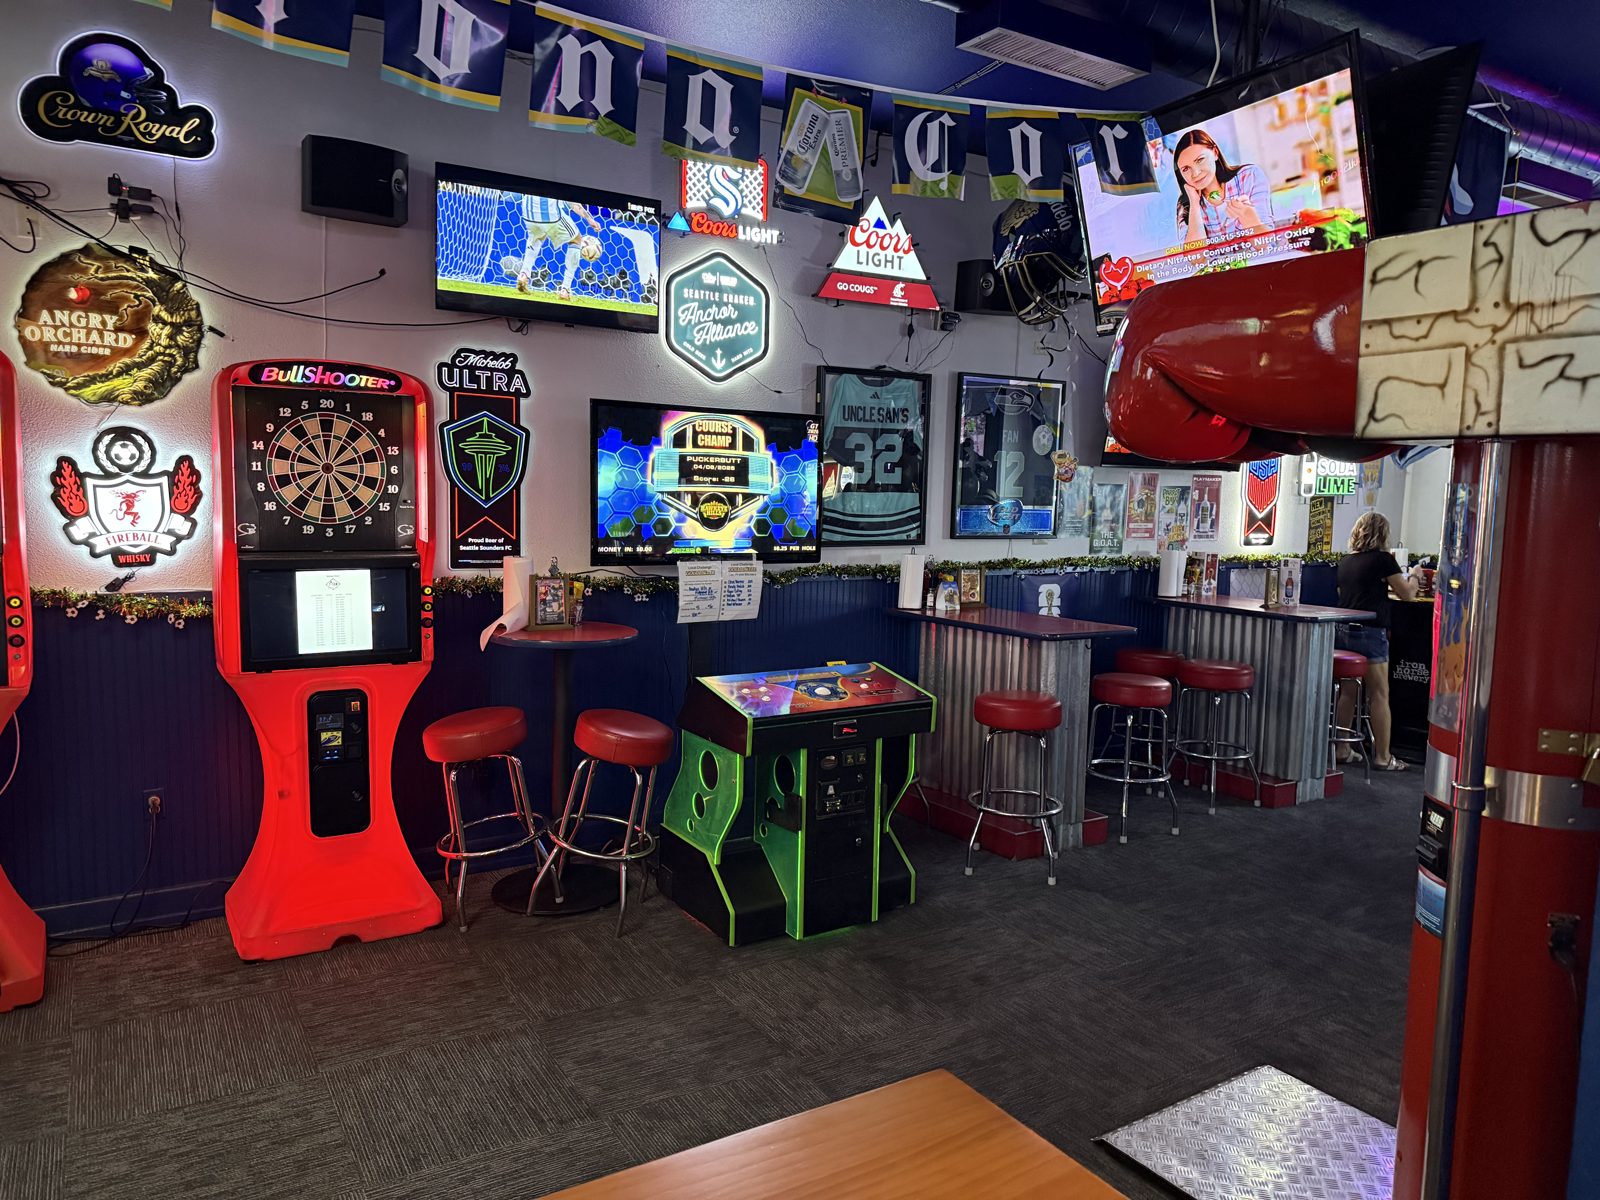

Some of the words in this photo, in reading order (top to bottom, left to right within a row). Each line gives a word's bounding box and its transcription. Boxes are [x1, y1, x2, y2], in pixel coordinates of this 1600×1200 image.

[37, 90, 115, 128] Crown
[98, 103, 200, 144] Royal
[796, 113, 820, 156] Corona
[835, 119, 849, 168] PREMIER
[1048, 201, 1074, 232] delo
[690, 212, 738, 238] Coors
[738, 225, 780, 244] LIGHT
[849, 218, 914, 255] Coors
[1136, 261, 1165, 273] Dietary
[1167, 253, 1201, 266] Nitrates
[1202, 244, 1239, 257] Convert
[1240, 241, 1252, 249] to
[1254, 233, 1282, 247] Nitric
[1284, 226, 1316, 239] Oxide
[1165, 246, 1182, 256] CALL
[856, 250, 905, 271] LIGHT
[1157, 269, 1170, 278] the
[1172, 264, 1194, 276] Body
[1195, 262, 1204, 270] to
[1207, 254, 1234, 267] Lower
[1237, 248, 1264, 261] Blood
[1266, 239, 1311, 255] Pressure
[836, 282, 849, 291] GO
[849, 284, 874, 294] COUGS
[683, 288, 720, 301] SEATTLE
[38, 309, 120, 331] ANGRY
[677, 302, 738, 326] Anchor
[24, 325, 134, 348] ORCHARD
[693, 321, 759, 345] Alliance
[50, 344, 78, 353] HARD
[80, 345, 112, 356] CIDER
[455, 352, 514, 370] Michelob
[442, 367, 527, 393] ULTRA
[301, 400, 309, 410] 5
[319, 399, 335, 409] 20
[345, 403, 351, 412] 1
[278, 408, 292, 417] 12
[361, 412, 374, 422] 18
[842, 405, 876, 423] UNCLE
[266, 423, 274, 432] 9
[377, 428, 386, 438] 4
[695, 420, 733, 434] COURSE
[697, 433, 732, 448] CHAMP
[1003, 429, 1020, 443] FAN
[252, 441, 265, 450] 14
[387, 446, 399, 455] 13
[686, 455, 742, 464] PUCKERBUTT
[844, 432, 904, 485] 32
[251, 462, 262, 471] 11
[390, 465, 398, 475] 6
[1249, 458, 1278, 480] USA
[1317, 457, 1357, 476] SODA
[993, 450, 1025, 498] 12
[257, 482, 266, 492] 8
[387, 485, 399, 494] 10
[1315, 476, 1356, 495] LIME
[263, 502, 277, 511] 16
[378, 502, 391, 511] 15
[283, 516, 291, 525] 7
[365, 516, 373, 525] 2
[302, 525, 315, 534] 19
[325, 528, 334, 537] 3
[344, 524, 356, 534] 17
[1101, 531, 1114, 539] THE
[105, 532, 161, 547] FIREBALL
[117, 553, 151, 564] WHISKY
[1396, 664, 1429, 676] horse
[1400, 659, 1425, 669] iron
[1393, 671, 1431, 684] brewery
